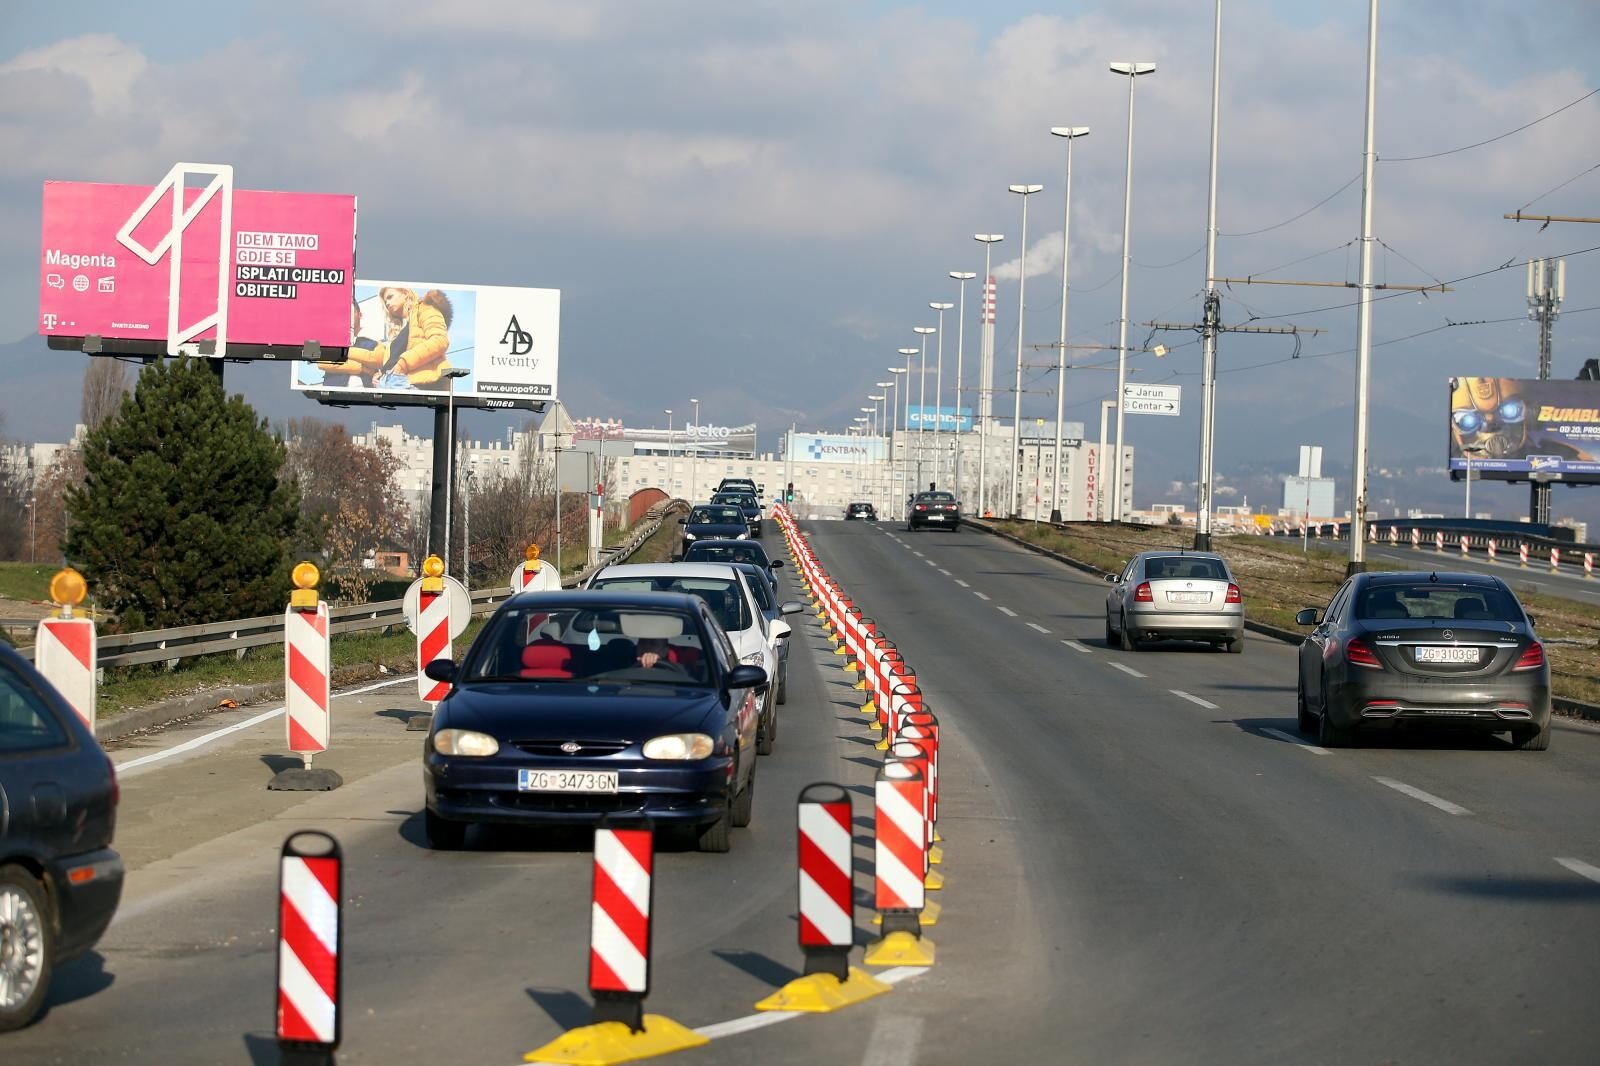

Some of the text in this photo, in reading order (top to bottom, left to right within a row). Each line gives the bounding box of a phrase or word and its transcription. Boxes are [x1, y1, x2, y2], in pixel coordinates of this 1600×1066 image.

[238, 233, 316, 249] IDEM TAMO
[46, 249, 116, 269] Magenta
[238, 250, 292, 264] GDJE SE
[237, 266, 344, 284] ISPLATI CIJELOJ
[236, 283, 296, 298] OBITELJI
[491, 355, 539, 370] twenty
[480, 383, 550, 394] www.europa92.hr
[1136, 388, 1164, 397] Jarun
[1132, 400, 1162, 410] Centar
[686, 422, 729, 438] beko
[1559, 425, 1571, 433] OD
[821, 443, 868, 455] KENTBANK
[1423, 648, 1435, 659] ZG
[530, 772, 548, 788] ZG
